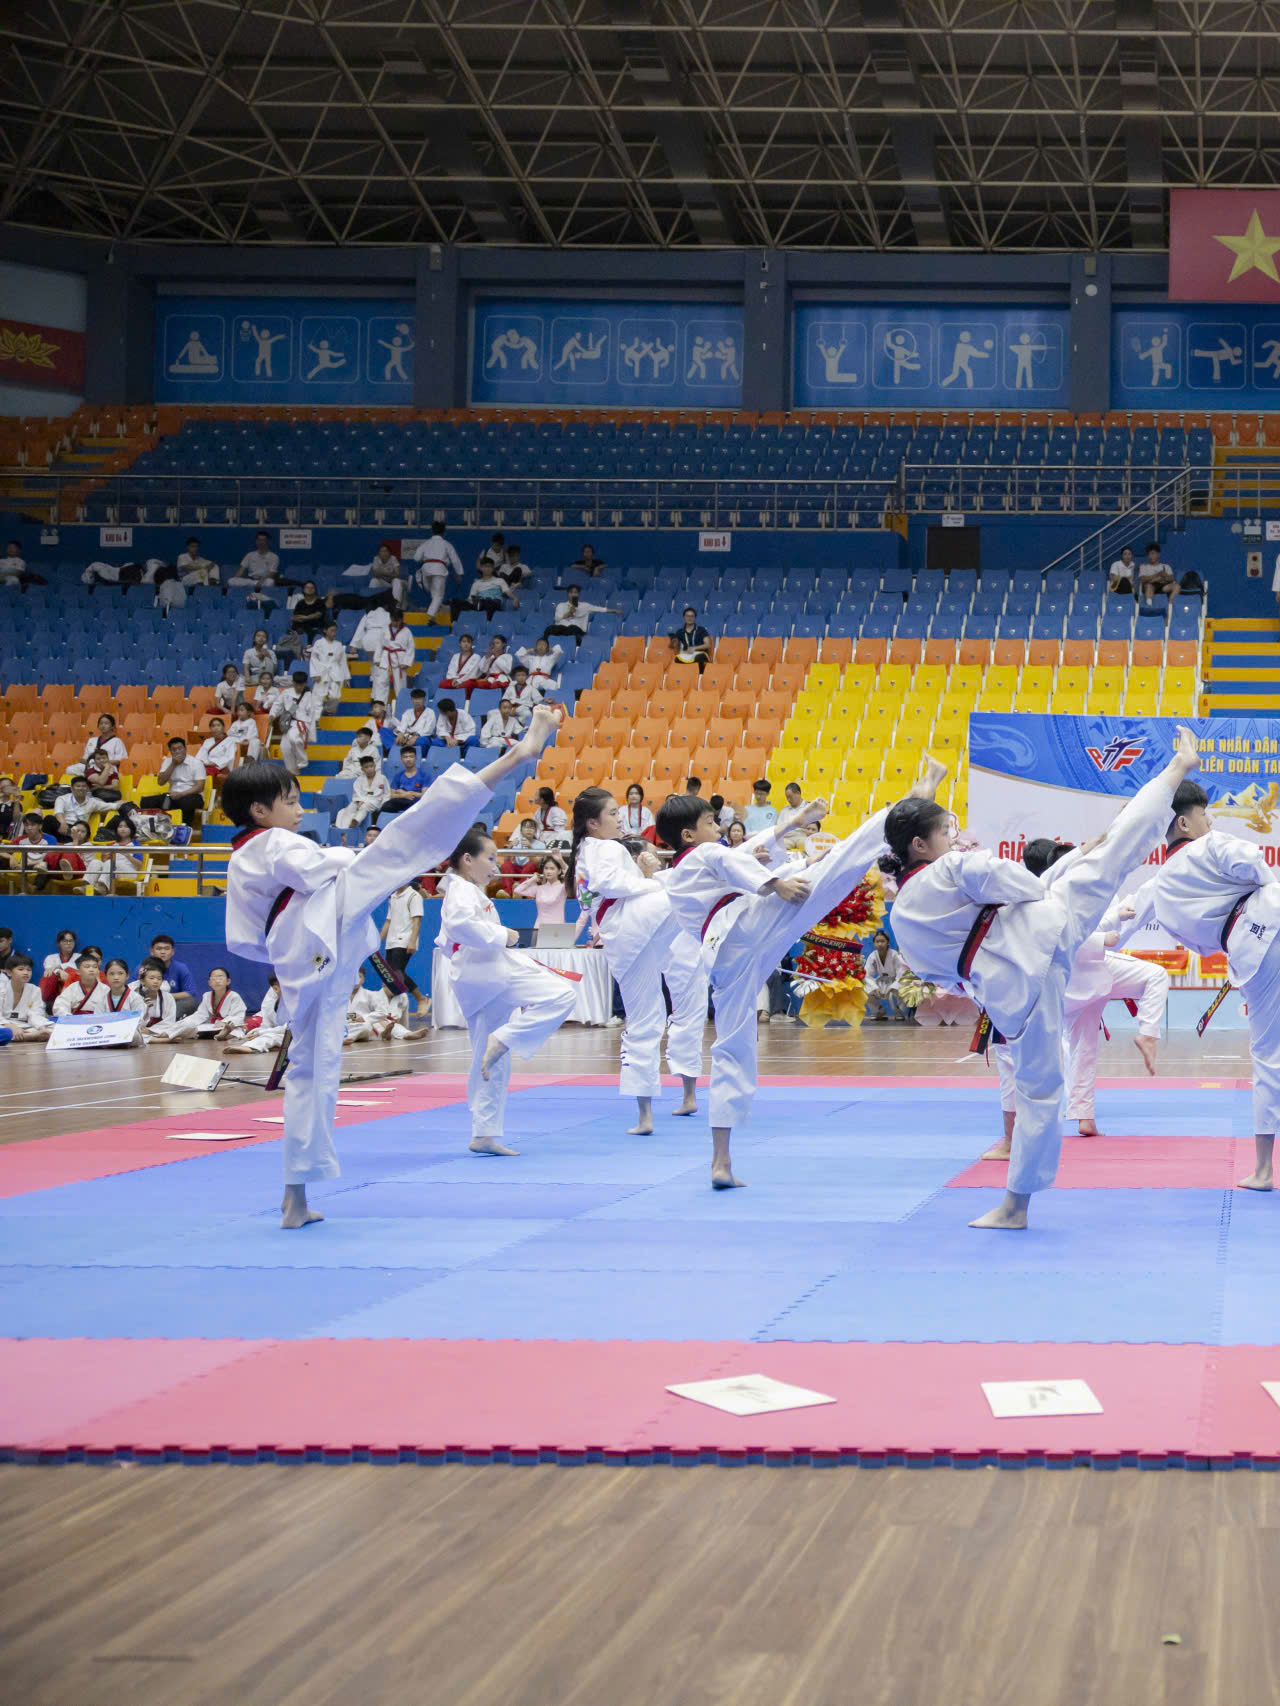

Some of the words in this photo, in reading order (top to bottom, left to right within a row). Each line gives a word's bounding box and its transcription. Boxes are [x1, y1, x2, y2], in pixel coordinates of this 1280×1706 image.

[1219, 736, 1250, 753] NHÂN
[1255, 736, 1278, 753] DÂN
[1199, 756, 1224, 773] LIÊN
[999, 833, 1026, 863] GIẢ
